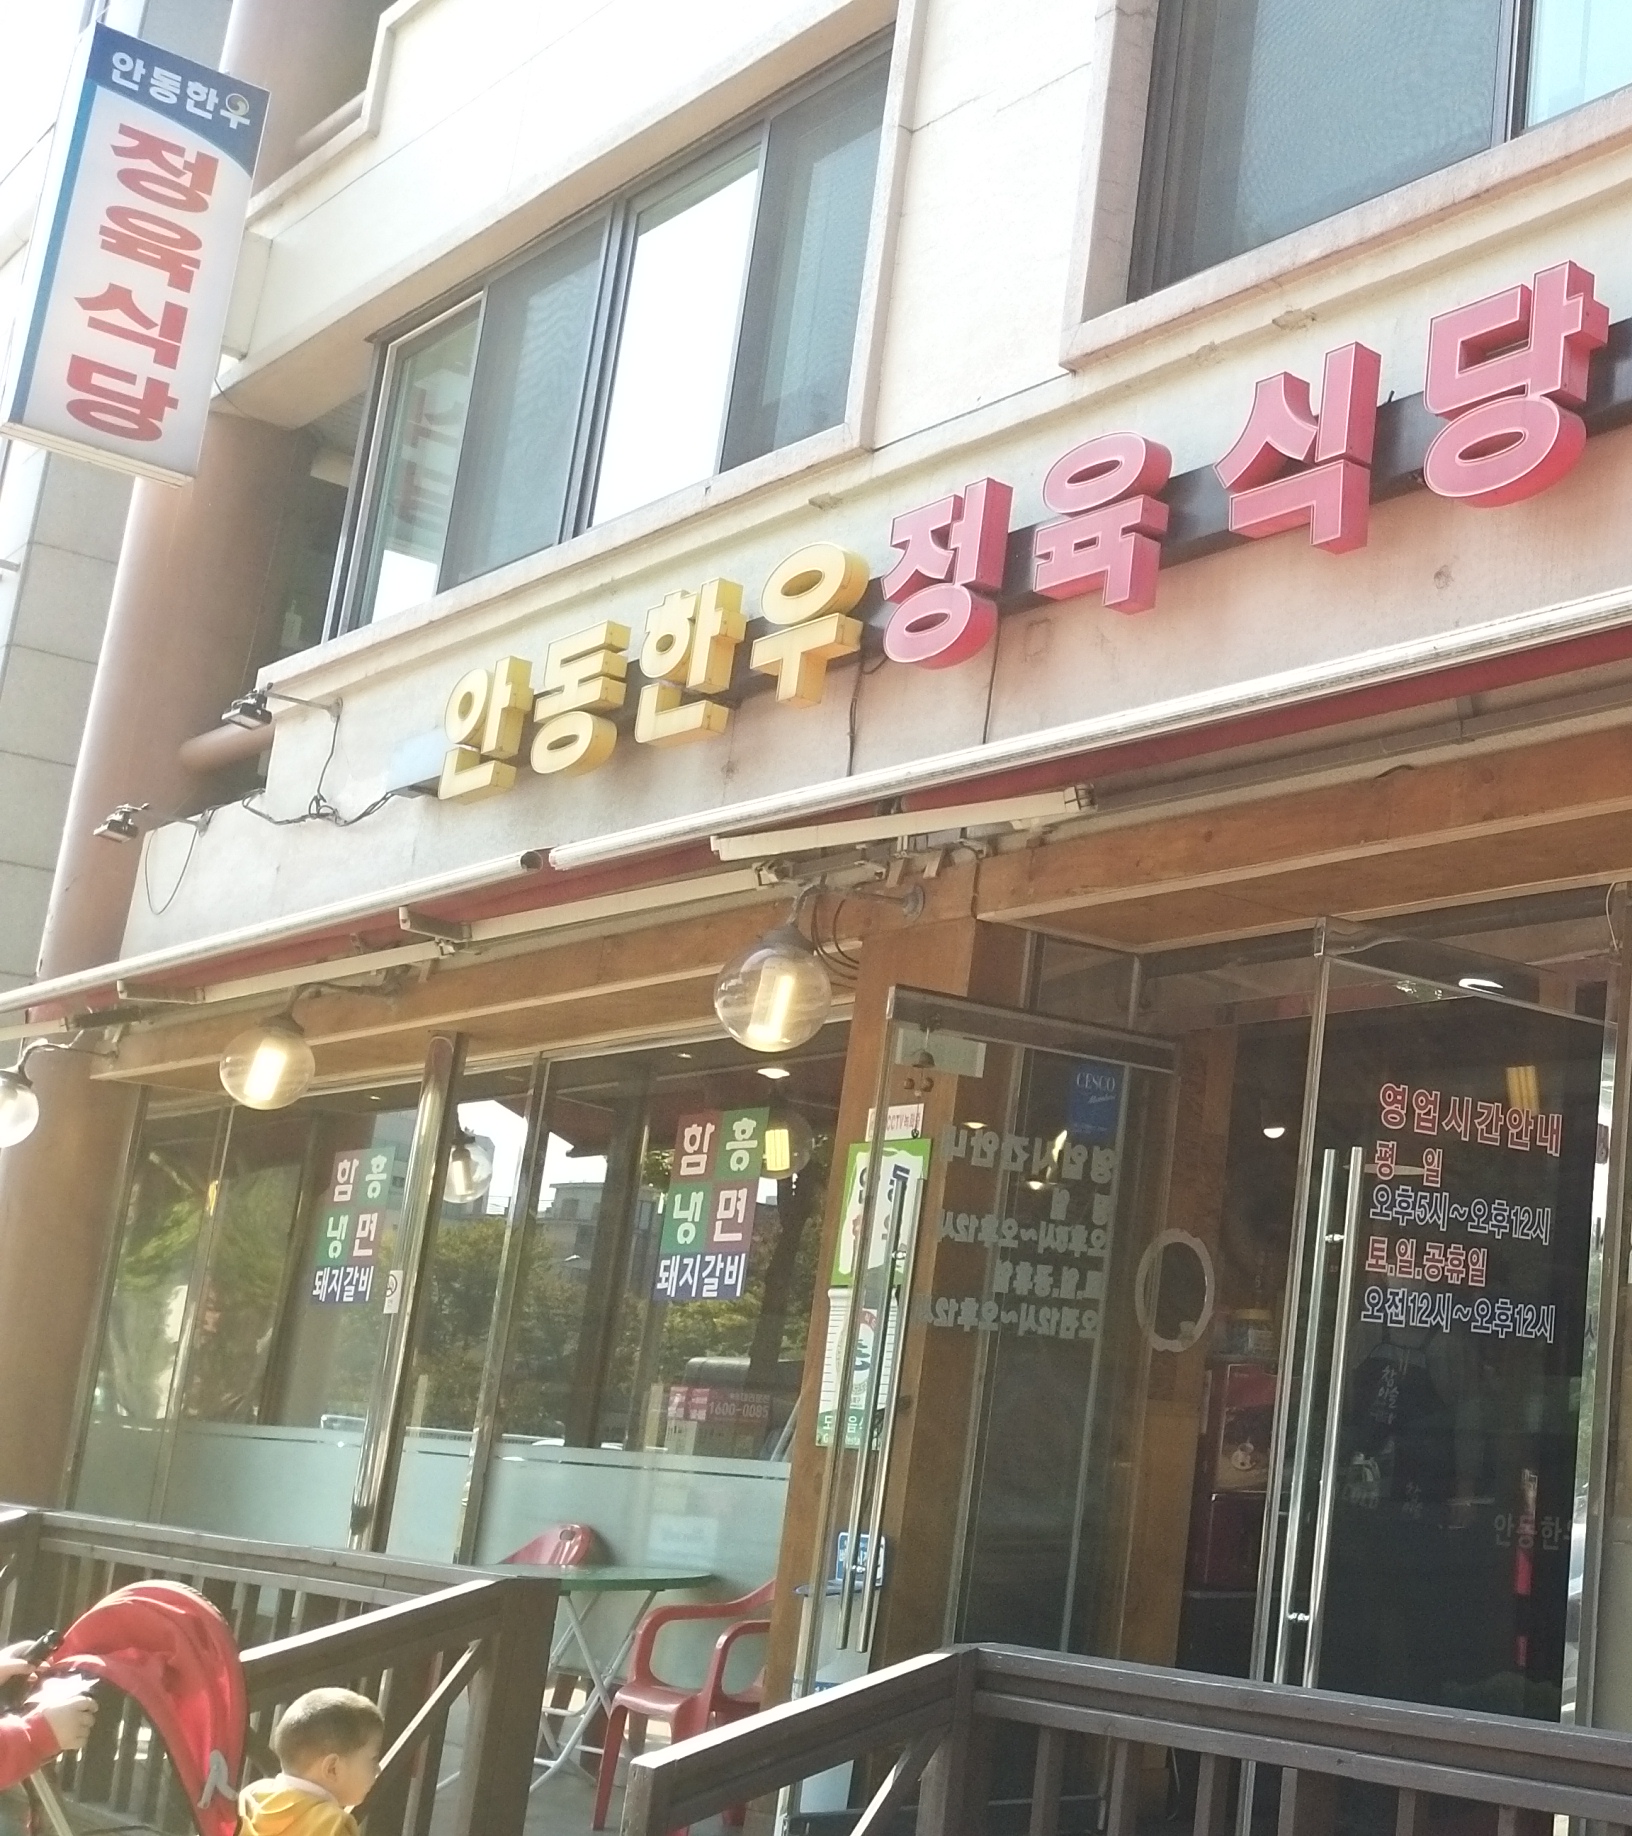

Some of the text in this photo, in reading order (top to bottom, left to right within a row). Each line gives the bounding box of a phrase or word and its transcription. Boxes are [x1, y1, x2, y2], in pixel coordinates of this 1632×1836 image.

[111, 51, 251, 130] 안동한우
[65, 122, 219, 442] 정육식당
[438, 259, 1609, 802] 안동한우 정육식당
[1076, 1072, 1116, 1092] CESCO
[680, 1117, 758, 1176] 함흥
[1379, 1082, 1564, 1158] 영업시간안내
[333, 1154, 388, 1202] 함흥
[326, 1212, 378, 1259] 냉면
[672, 1187, 748, 1245] 냉면
[312, 1265, 375, 1303] 돼지갈비
[656, 1252, 746, 1298] 돼지갈비
